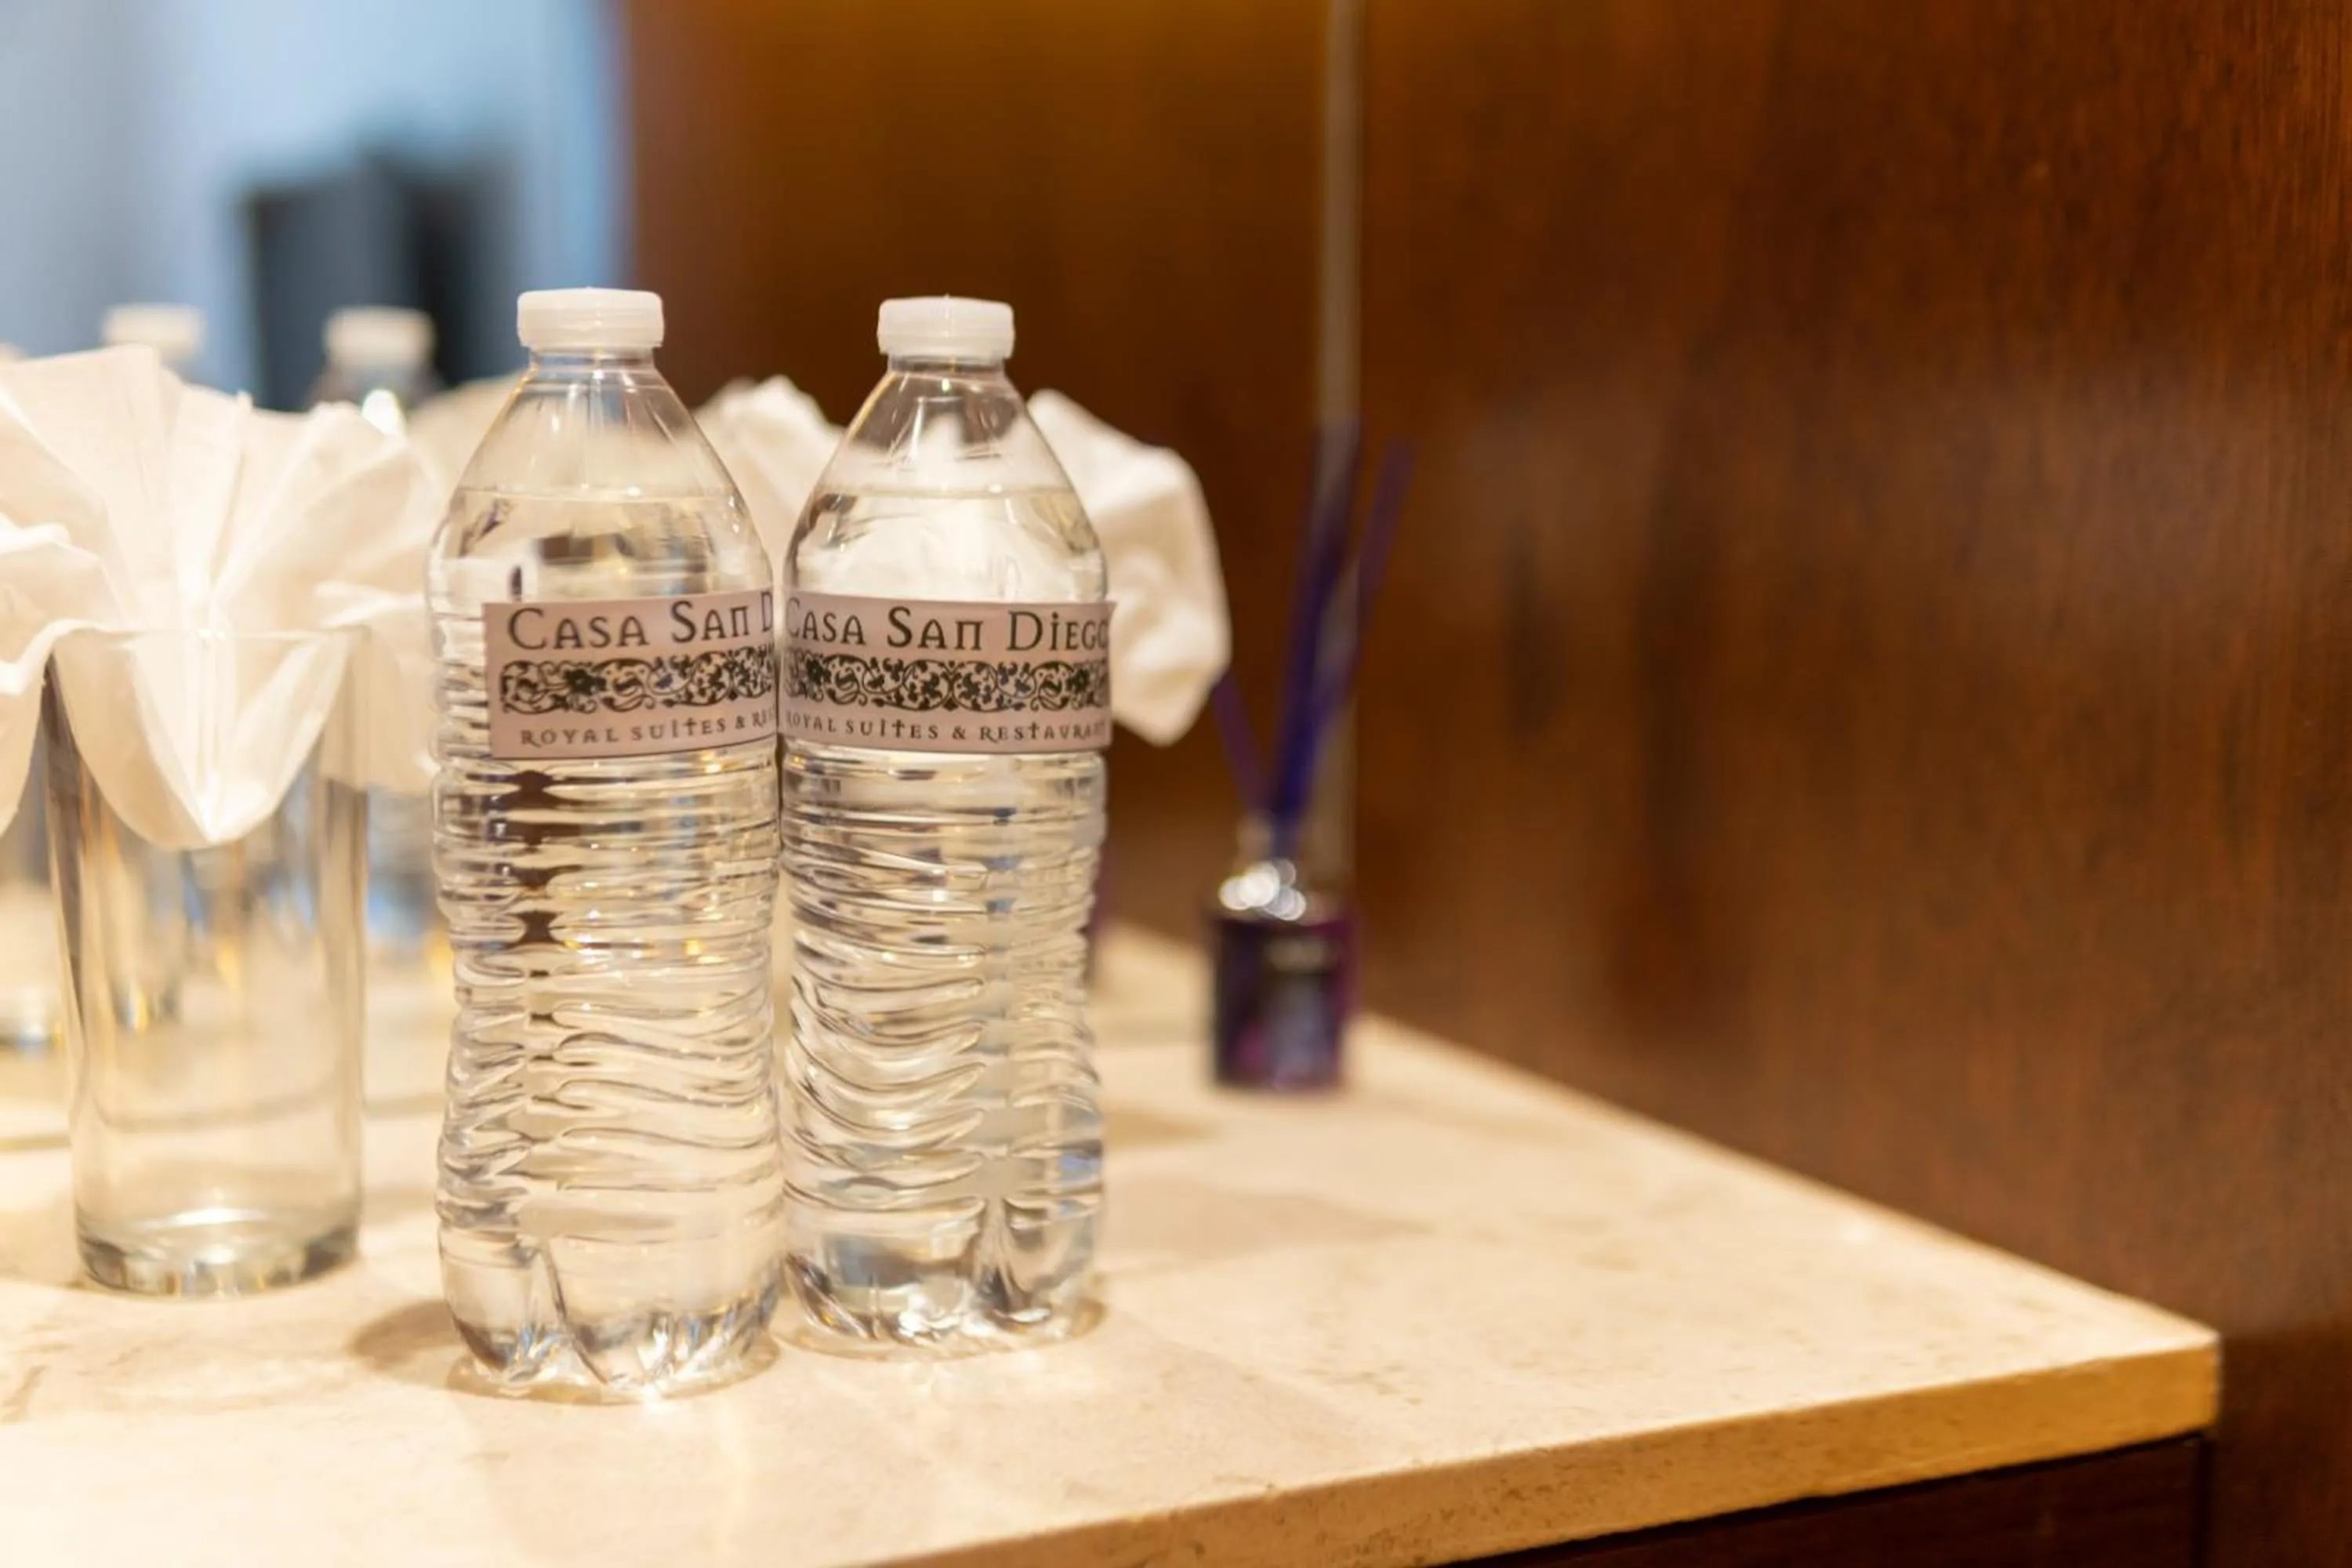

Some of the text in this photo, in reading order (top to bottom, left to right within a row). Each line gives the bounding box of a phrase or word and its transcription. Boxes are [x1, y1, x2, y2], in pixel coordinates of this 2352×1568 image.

[507, 607, 650, 651] CASA
[786, 597, 867, 646] CASA
[521, 728, 619, 747] ROYAL
[630, 717, 727, 742] SUITES
[845, 718, 939, 740] SUITES
[951, 727, 967, 740] &
